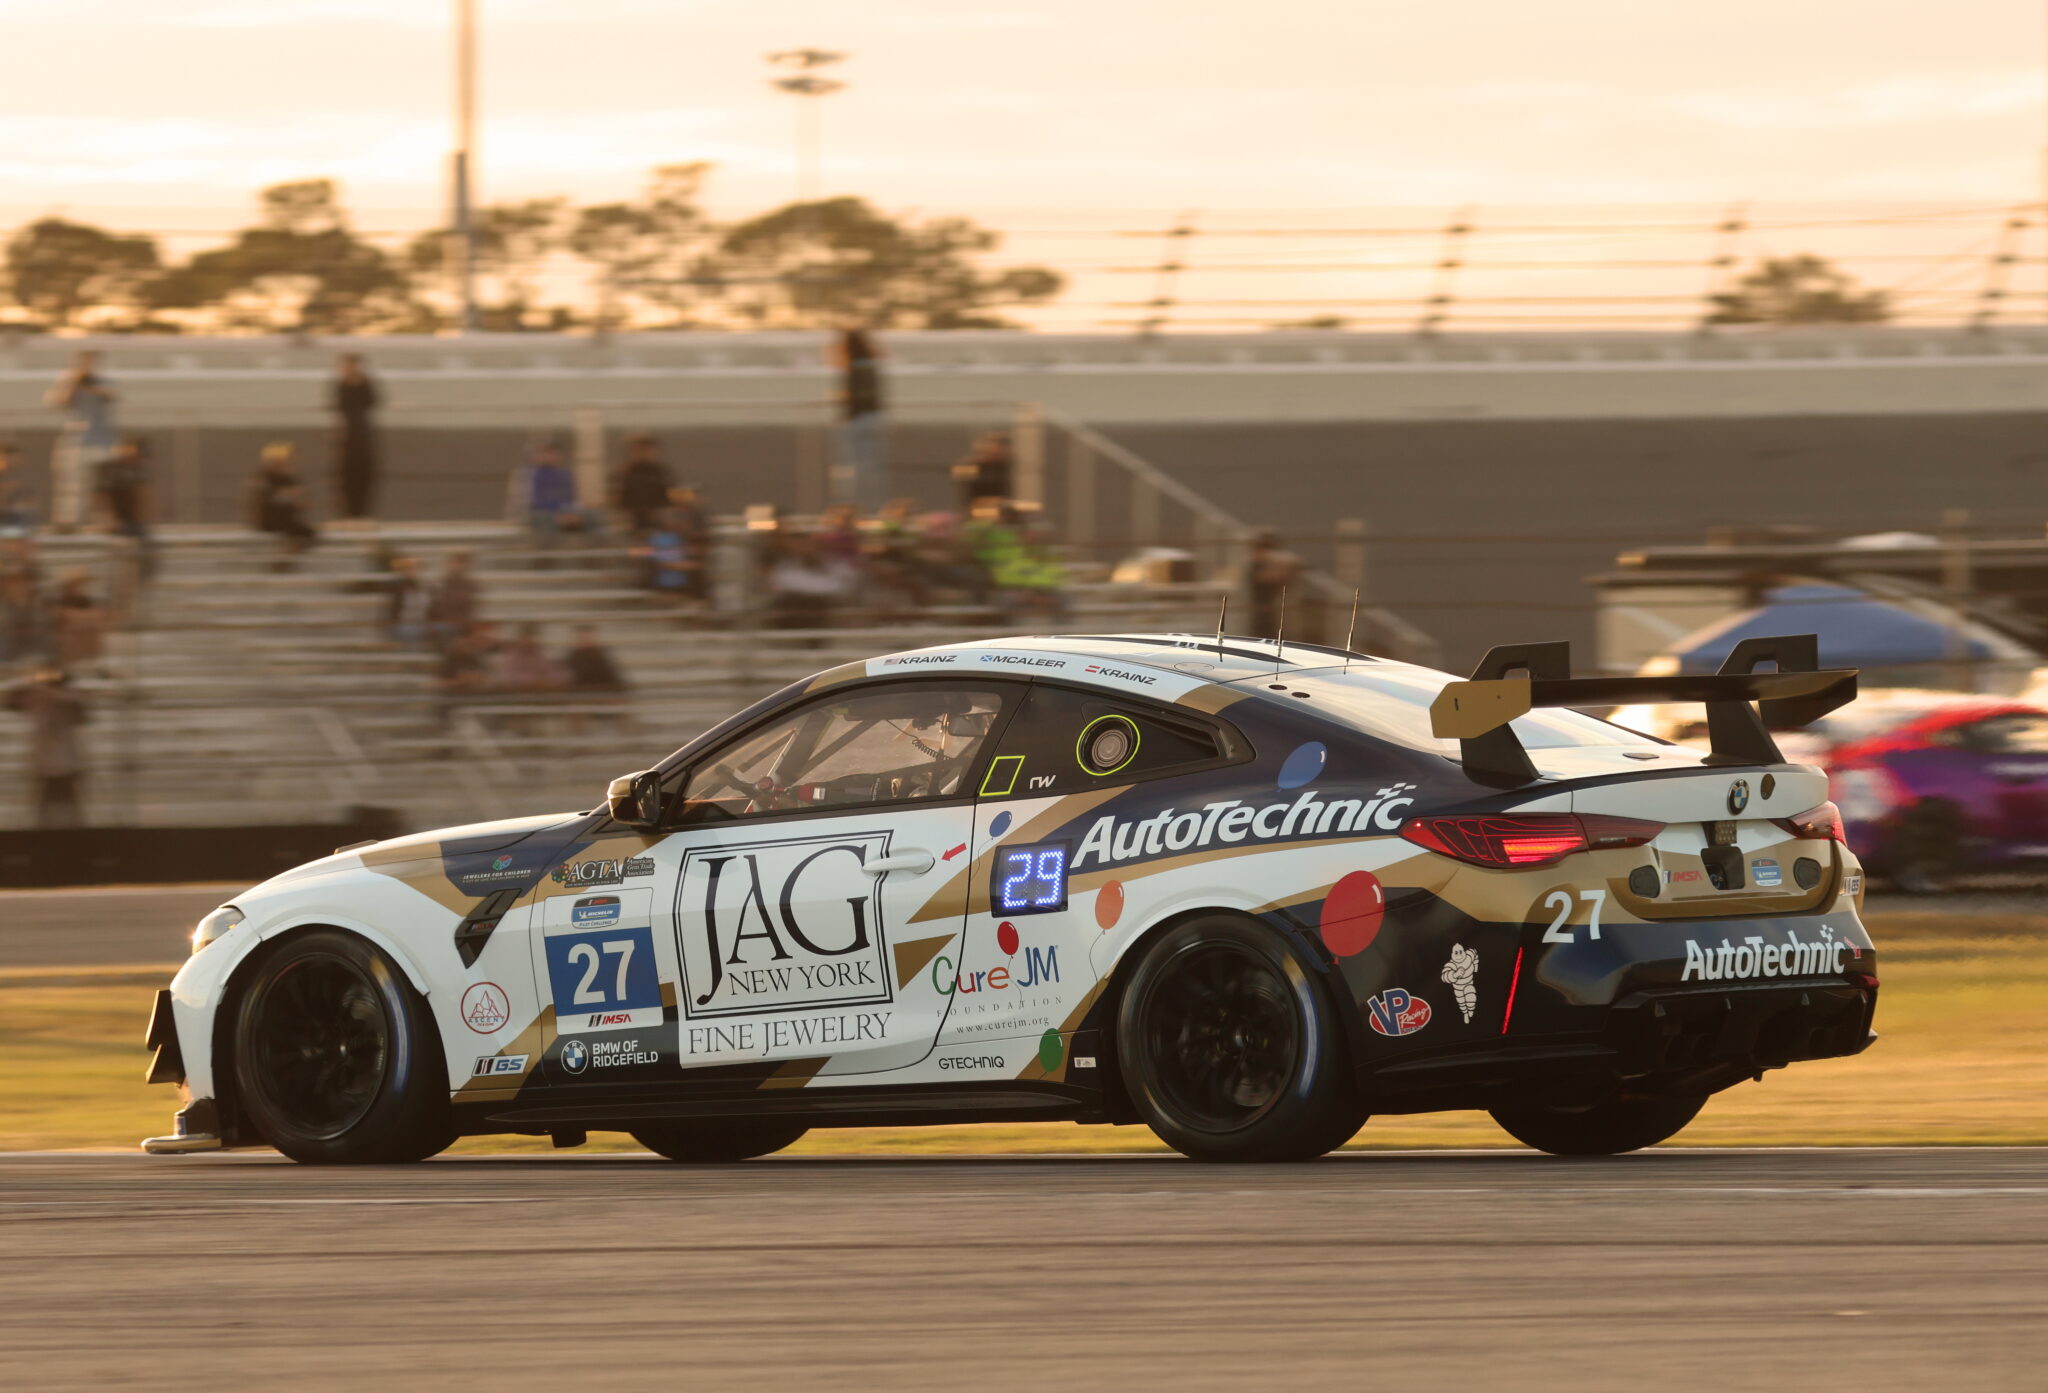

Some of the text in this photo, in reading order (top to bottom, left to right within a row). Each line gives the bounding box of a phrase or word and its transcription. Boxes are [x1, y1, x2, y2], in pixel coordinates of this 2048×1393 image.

[899, 655, 957, 666] KRAINZ
[992, 654, 1066, 669] MCALEER
[1099, 667, 1157, 686] KRAINZ
[1068, 783, 1414, 868] AutoTechnic
[567, 860, 620, 881] AGTA
[1003, 850, 1065, 908] 29
[697, 843, 871, 1006] JAG
[1542, 889, 1607, 944] 27
[1681, 925, 1846, 982] AutoTechnic
[567, 939, 636, 1006] 27
[728, 960, 876, 996] NEW YORK
[932, 945, 1060, 996] Cure JM
[937, 997, 1063, 1018] FOUNDATION
[1367, 988, 1411, 1035] VP
[601, 1013, 632, 1025] IMSA
[956, 1017, 1050, 1034] www.curejm.org
[688, 1012, 892, 1056] FINE JEWELRY
[592, 1040, 638, 1055] BMW OF
[495, 1058, 524, 1071] GS
[593, 1051, 659, 1068] RIDGEFIELD
[938, 1056, 1005, 1070] GTECHNIQ
